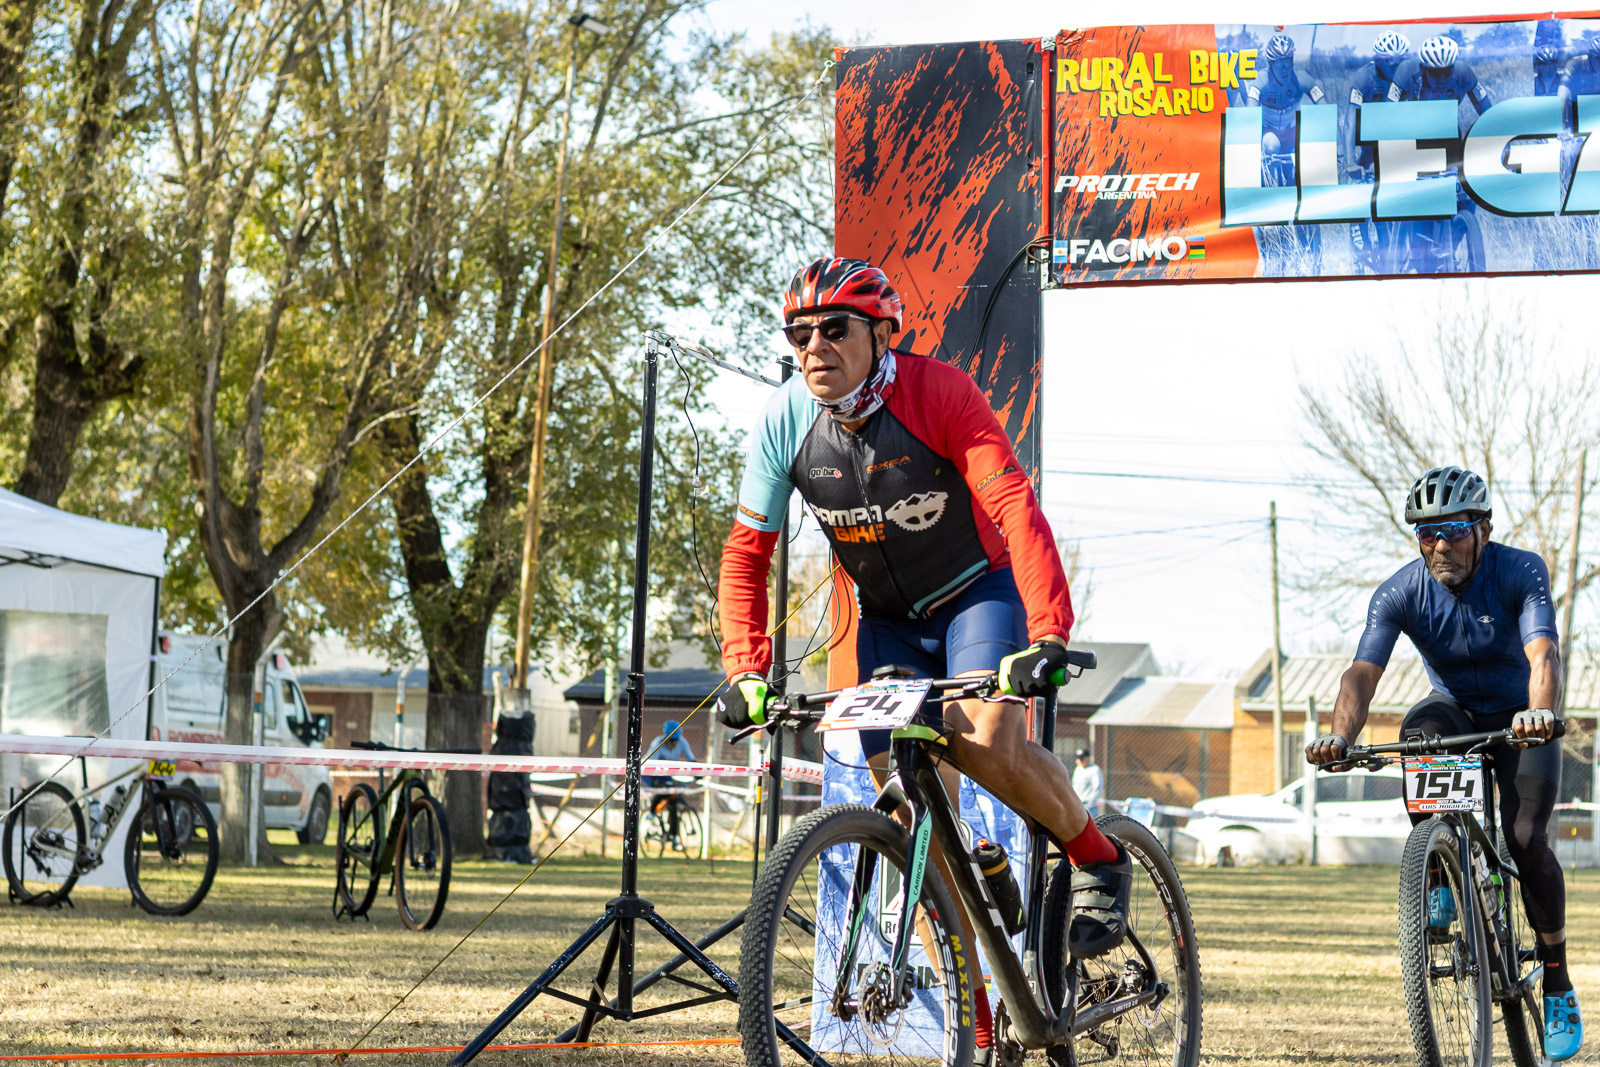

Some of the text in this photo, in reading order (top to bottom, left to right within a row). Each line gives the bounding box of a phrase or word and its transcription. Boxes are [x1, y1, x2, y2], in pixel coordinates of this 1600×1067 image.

[1056, 48, 1258, 93] RURAL BIKE
[1099, 86, 1215, 118] ROSARIO
[1054, 172, 1200, 193] PROTECH
[1094, 190, 1157, 200] ARGENTINA
[1069, 235, 1188, 264] FACIMO
[809, 502, 883, 527] PAMPA
[832, 522, 886, 544] BIKE
[838, 694, 903, 718] 24
[1414, 771, 1476, 799] 154
[913, 829, 929, 896] CARBON LIMITED
[950, 934, 971, 1028] MAXXIS
